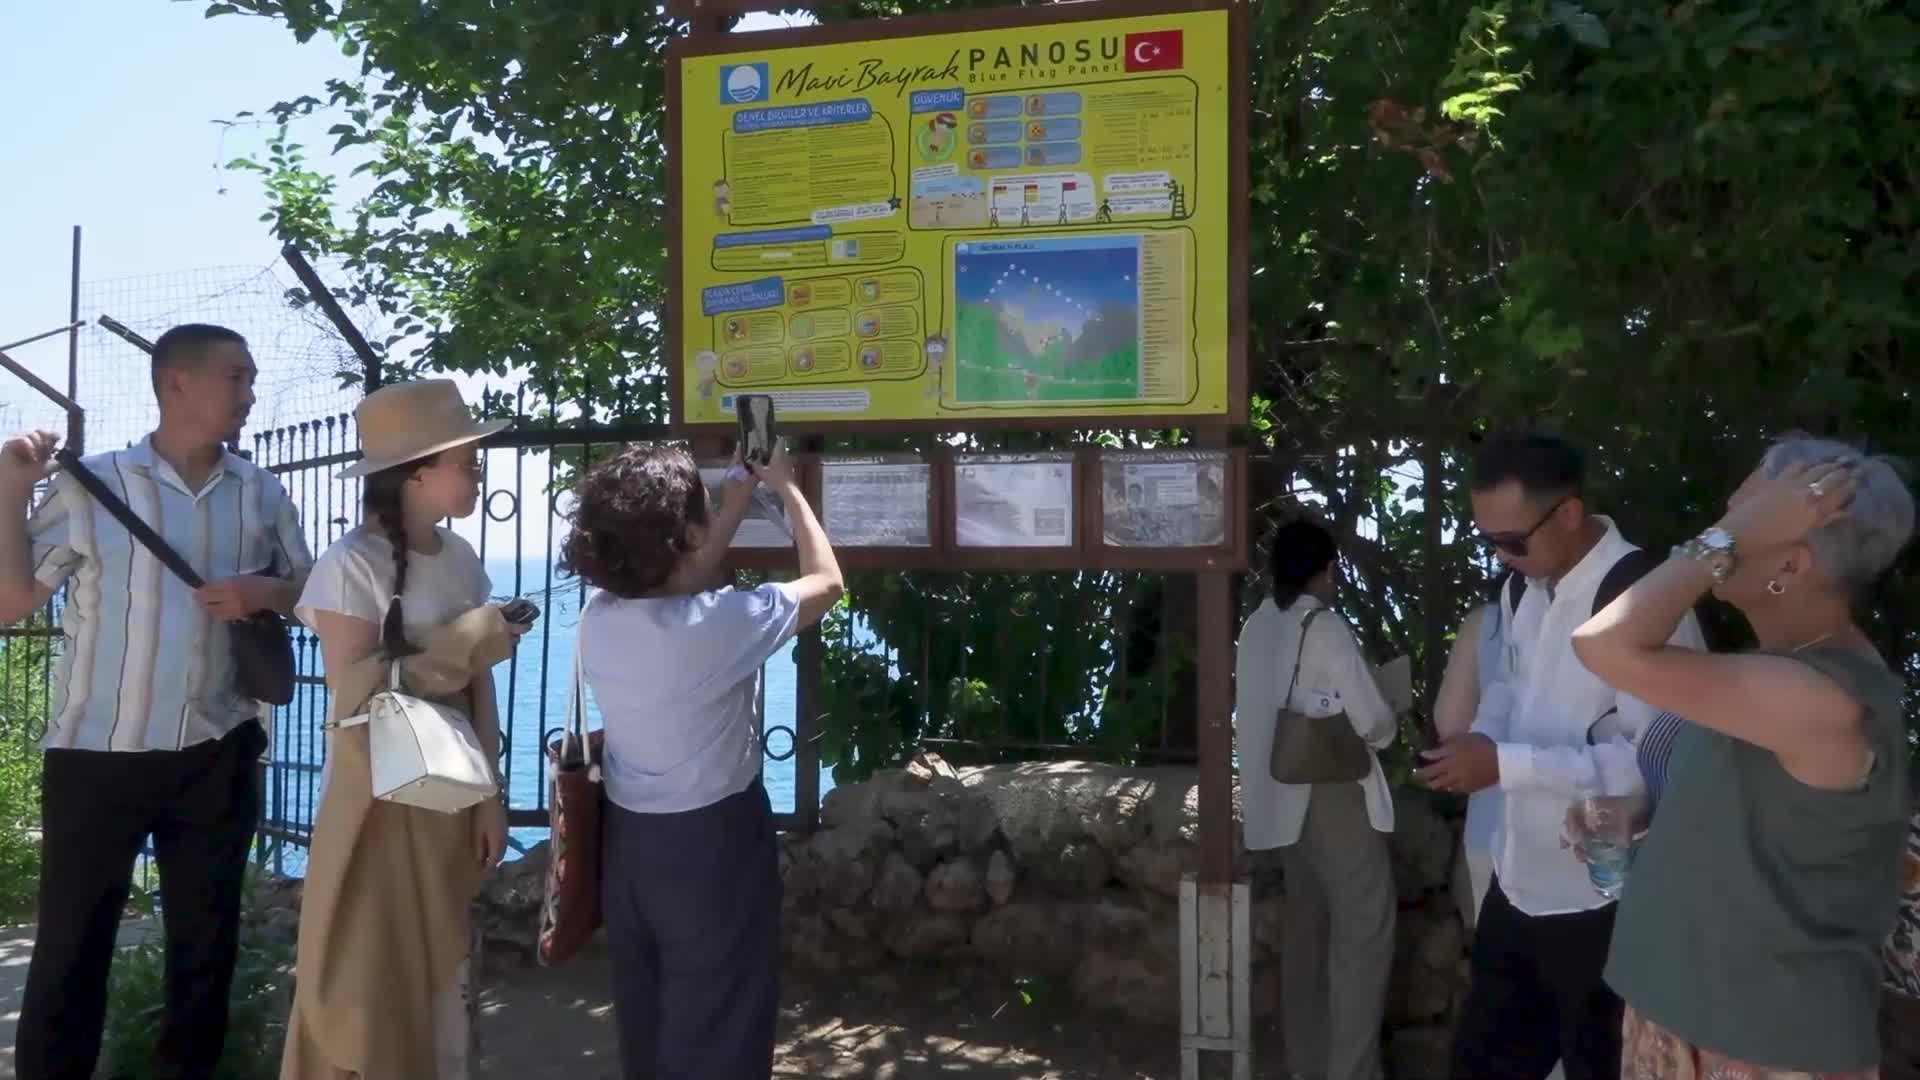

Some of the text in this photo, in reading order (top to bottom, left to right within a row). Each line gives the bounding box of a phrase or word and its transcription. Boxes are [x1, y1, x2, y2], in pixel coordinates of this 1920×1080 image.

[776, 37, 1118, 97] Mavi Bayrak PANOSU
[969, 62, 1118, 83] Blue Flag Panel
